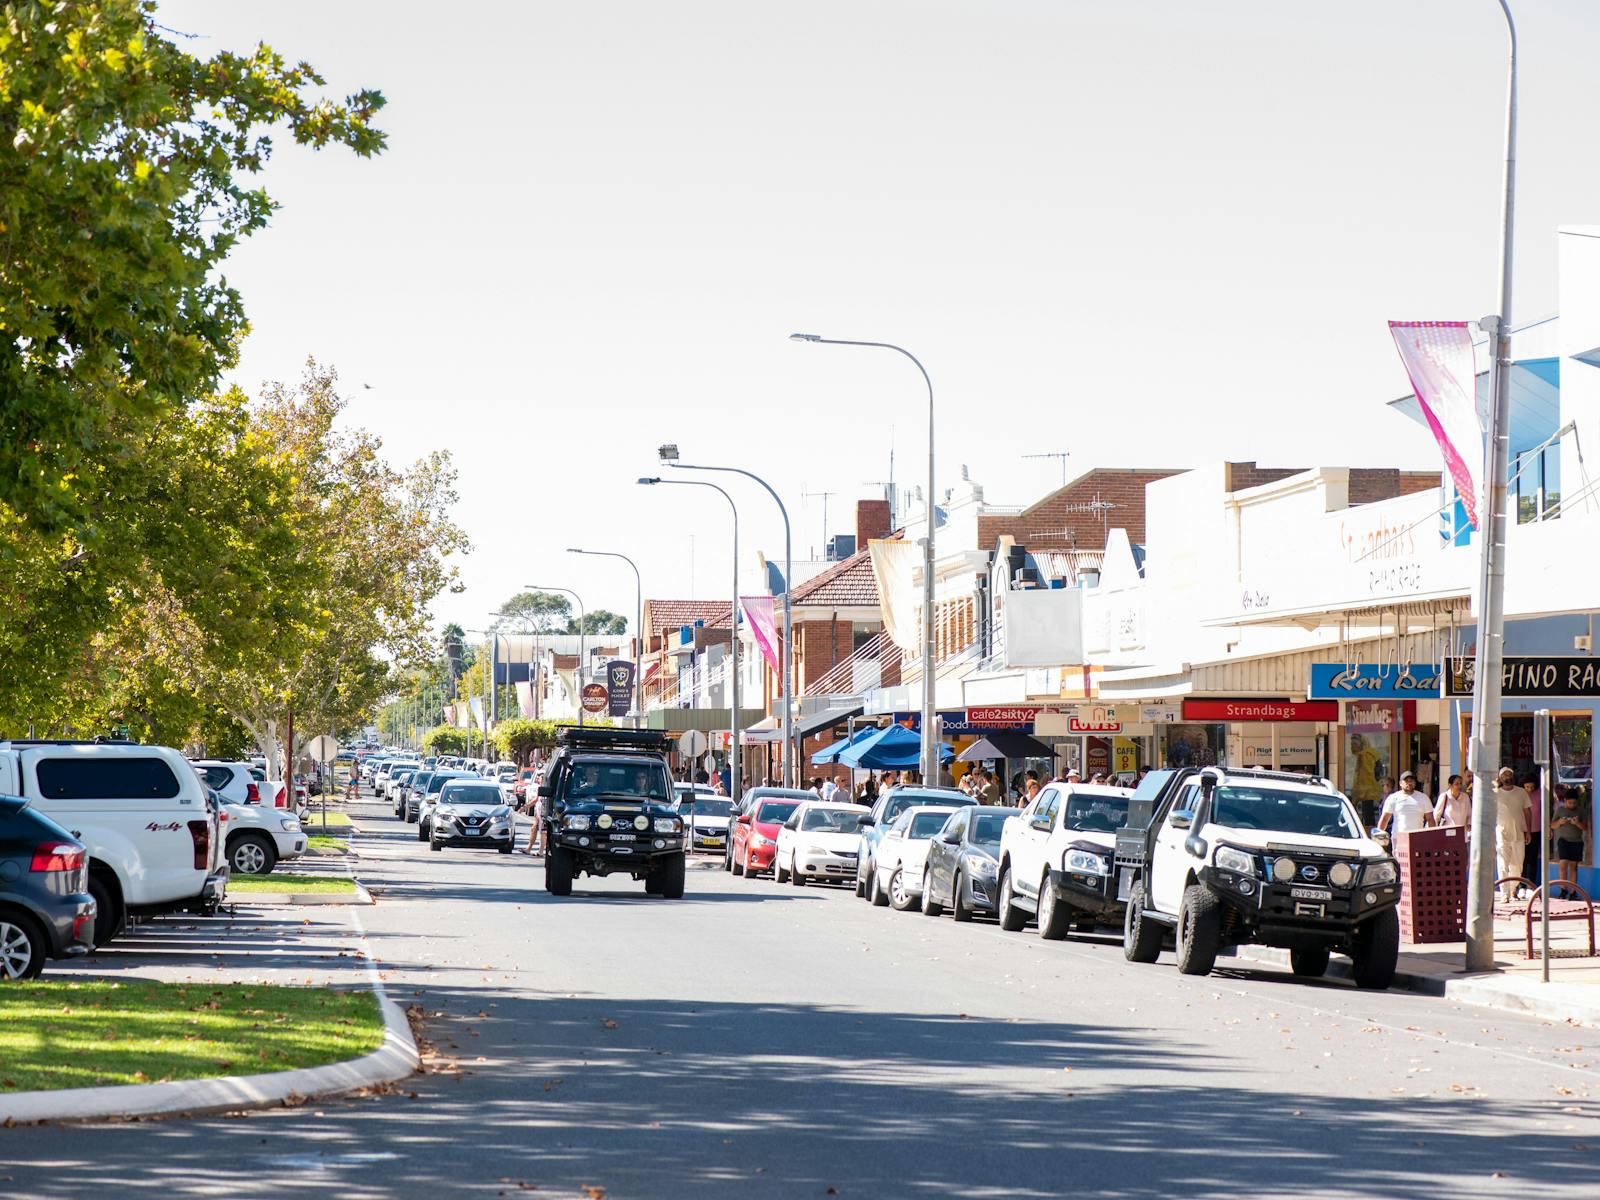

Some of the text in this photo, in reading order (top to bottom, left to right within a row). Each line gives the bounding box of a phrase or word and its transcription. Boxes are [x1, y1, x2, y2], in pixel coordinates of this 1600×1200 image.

[1502, 663, 1600, 690] HINO RA
[971, 709, 1035, 720] cafe2sixty2
[1227, 705, 1295, 718] Strandbags
[941, 721, 968, 729] Dodd
[1071, 718, 1118, 730] LOWES
[1116, 747, 1135, 755] CAFE
[145, 821, 183, 831] 4x4
